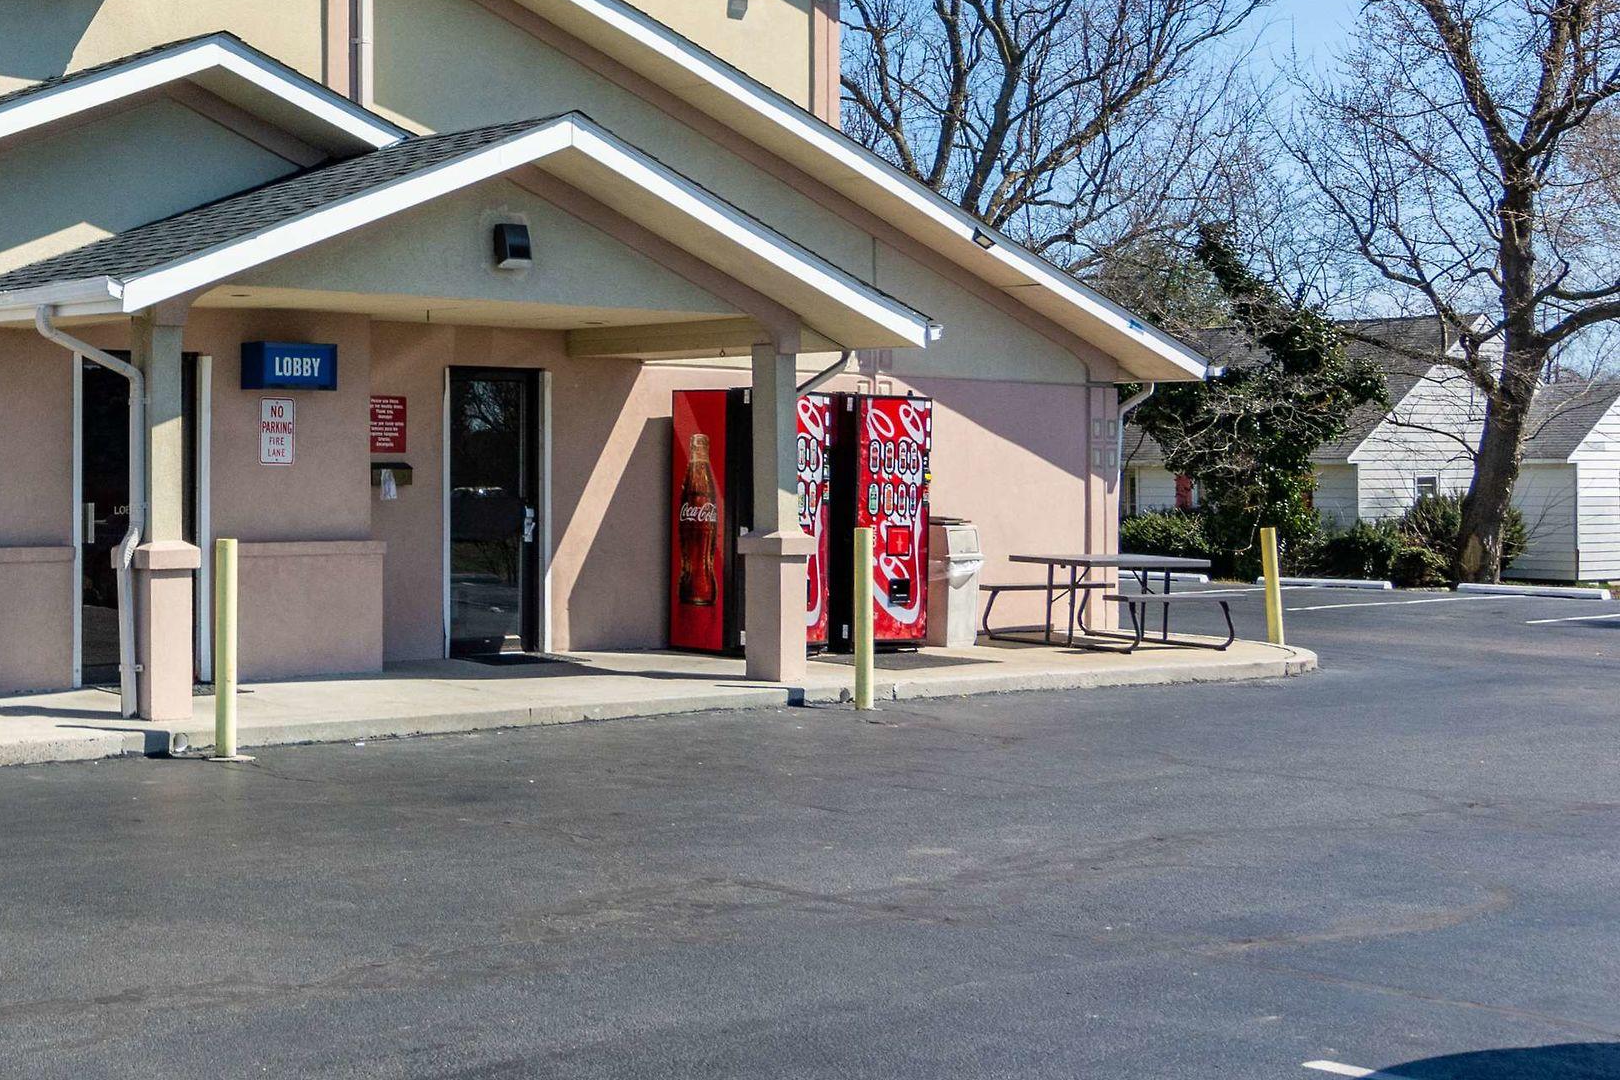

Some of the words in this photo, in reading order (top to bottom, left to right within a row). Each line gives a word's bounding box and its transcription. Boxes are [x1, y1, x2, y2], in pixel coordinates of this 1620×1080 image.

[275, 356, 321, 377] LOBBY
[270, 405, 284, 418] NO
[261, 421, 292, 434] PARKING
[269, 436, 285, 446] FIRE
[267, 448, 286, 458] LANE
